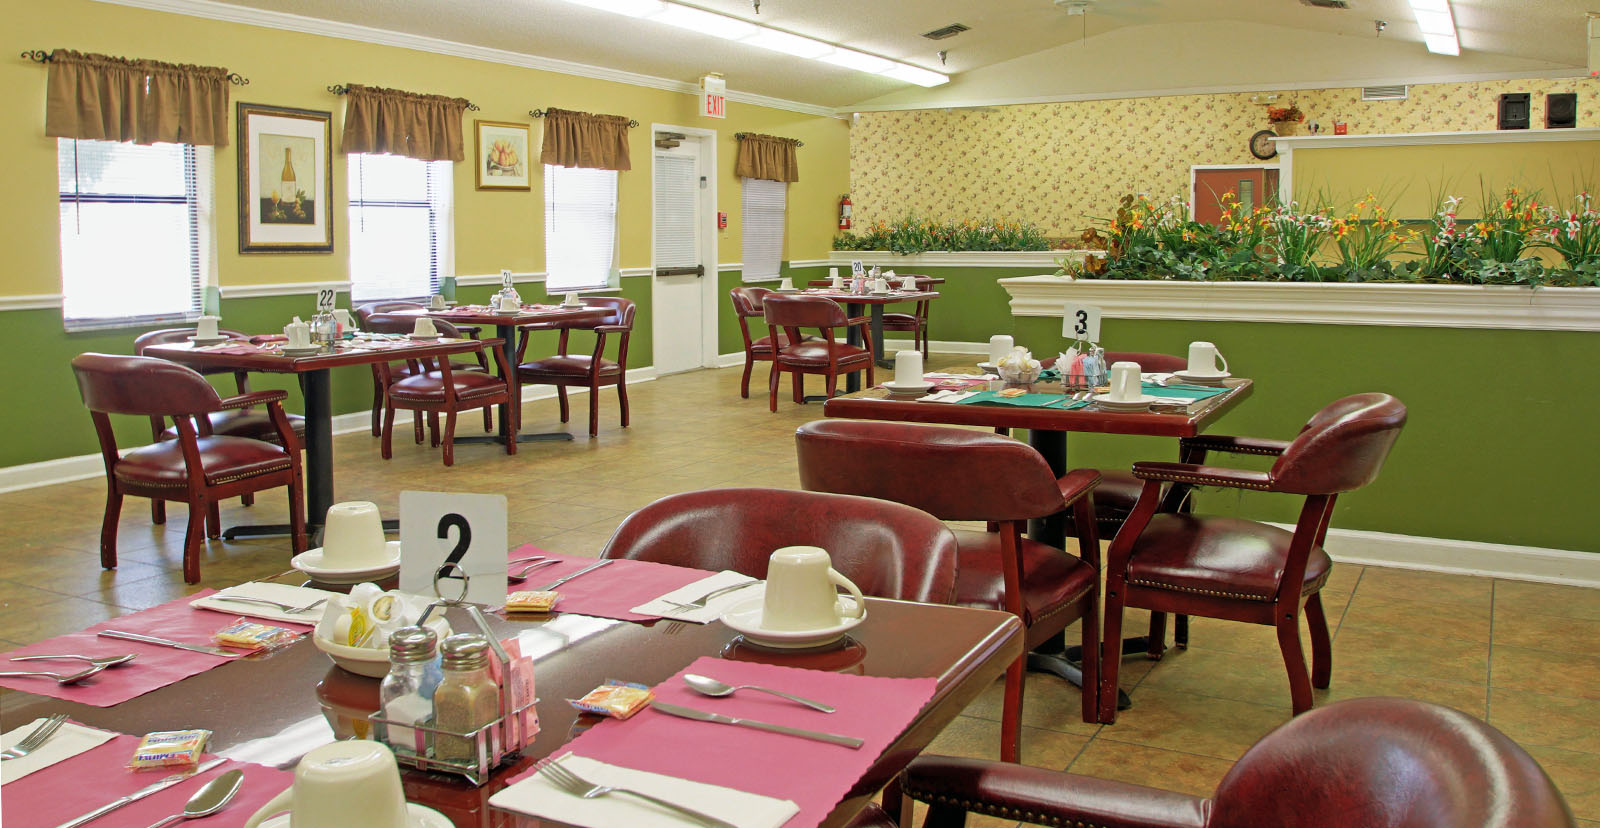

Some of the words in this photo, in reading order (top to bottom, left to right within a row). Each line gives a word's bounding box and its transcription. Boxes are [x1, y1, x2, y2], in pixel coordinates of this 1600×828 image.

[707, 94, 724, 116] EXIT
[854, 262, 862, 271] 20
[320, 289, 334, 306] 22
[1074, 309, 1088, 334] 3
[437, 512, 472, 581] 2
